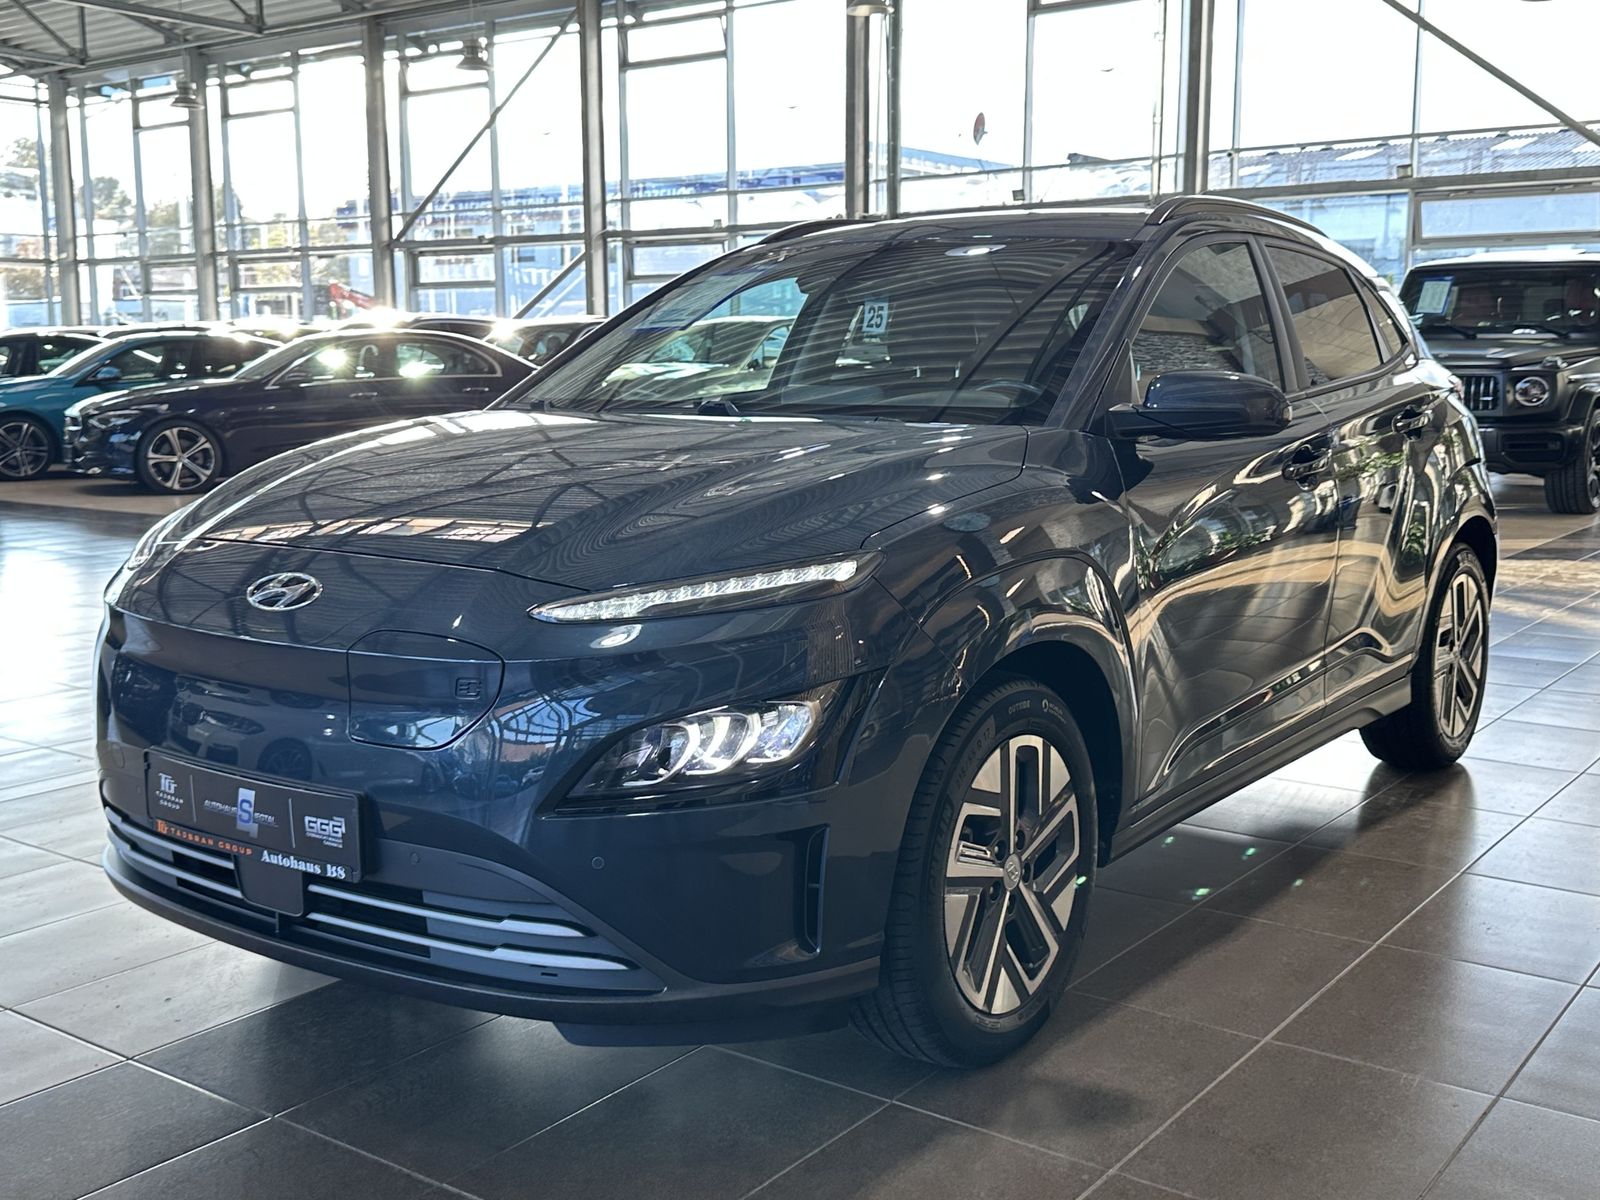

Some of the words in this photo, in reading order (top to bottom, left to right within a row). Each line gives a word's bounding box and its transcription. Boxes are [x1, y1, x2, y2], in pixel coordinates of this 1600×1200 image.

[865, 305, 884, 328] 25
[218, 841, 253, 856] GROUP
[261, 850, 321, 875] Autohaus
[326, 864, 346, 880] B8
